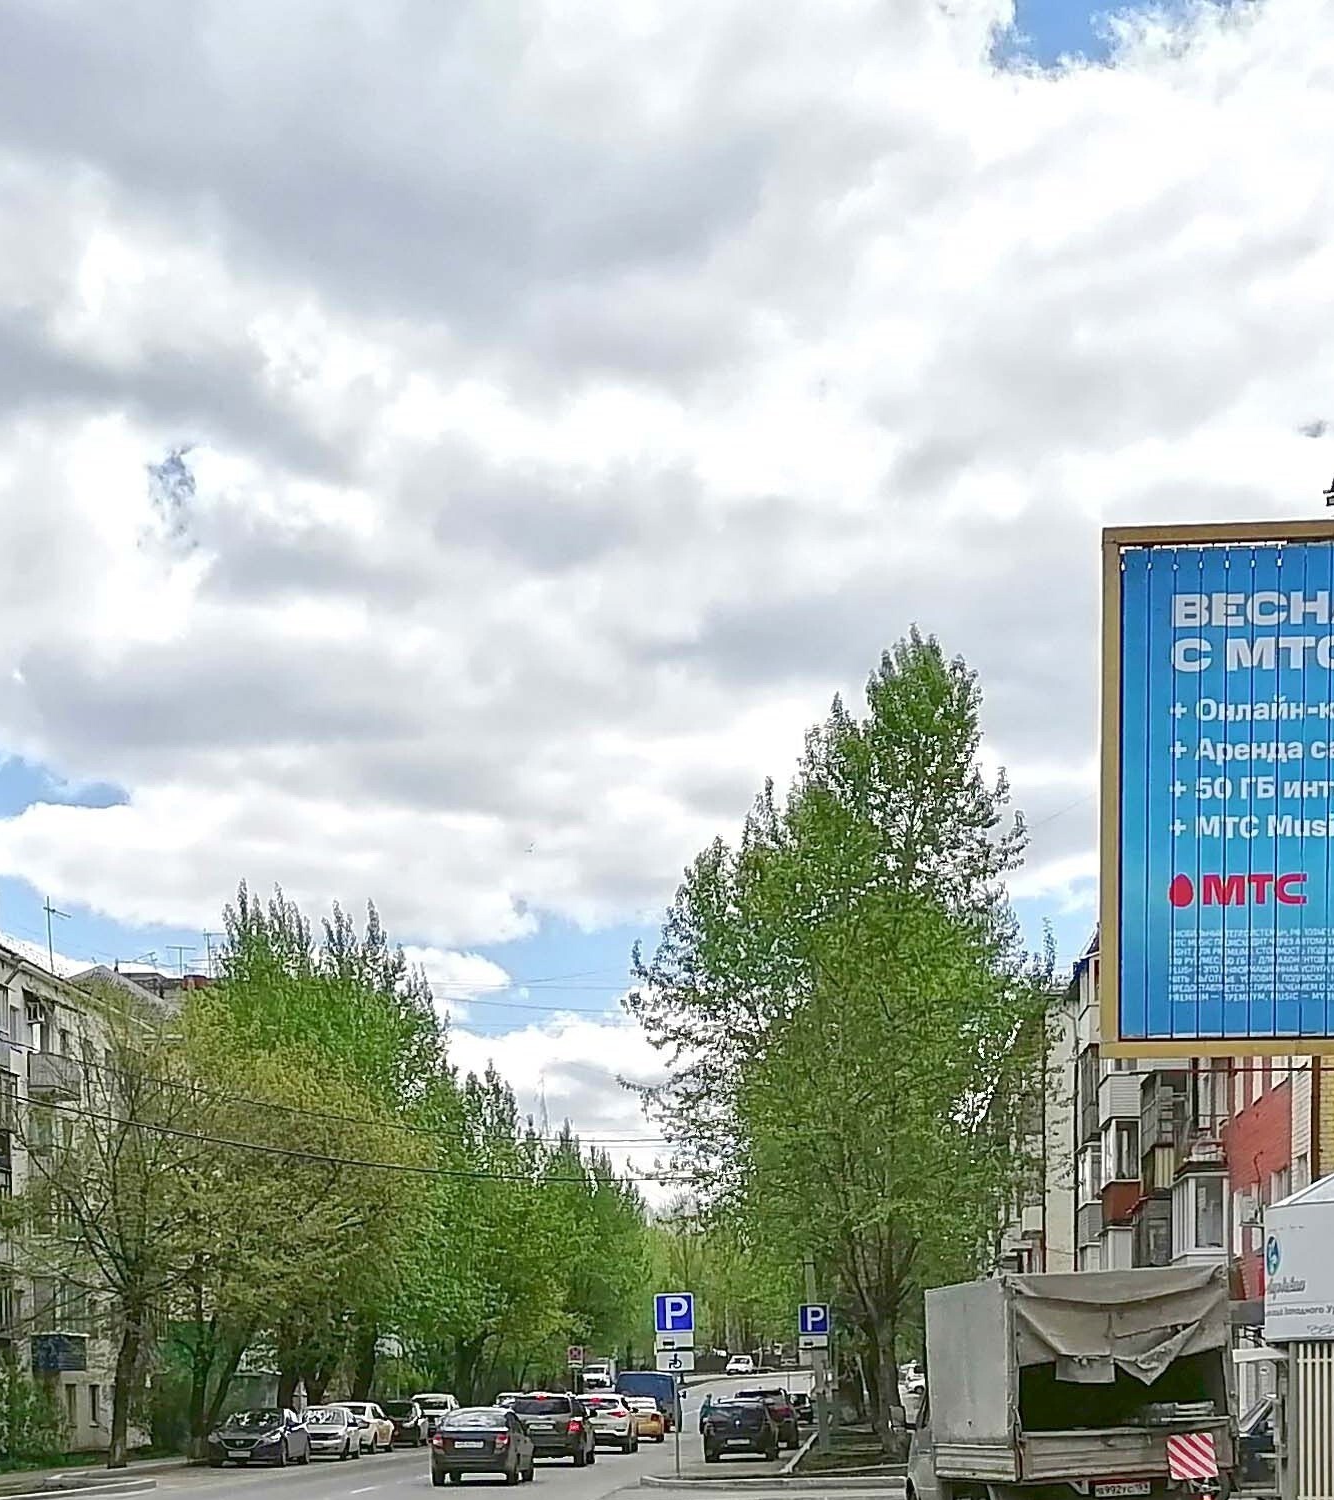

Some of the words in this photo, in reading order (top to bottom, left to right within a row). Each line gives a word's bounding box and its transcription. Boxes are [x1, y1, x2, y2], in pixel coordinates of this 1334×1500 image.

[1171, 637, 1213, 673] С
[1195, 737, 1303, 765] Аренда
[1195, 777, 1232, 800] 50
[1240, 776, 1276, 800] ГБ
[1195, 815, 1260, 838] МТС
[1202, 873, 1308, 906] МТС
